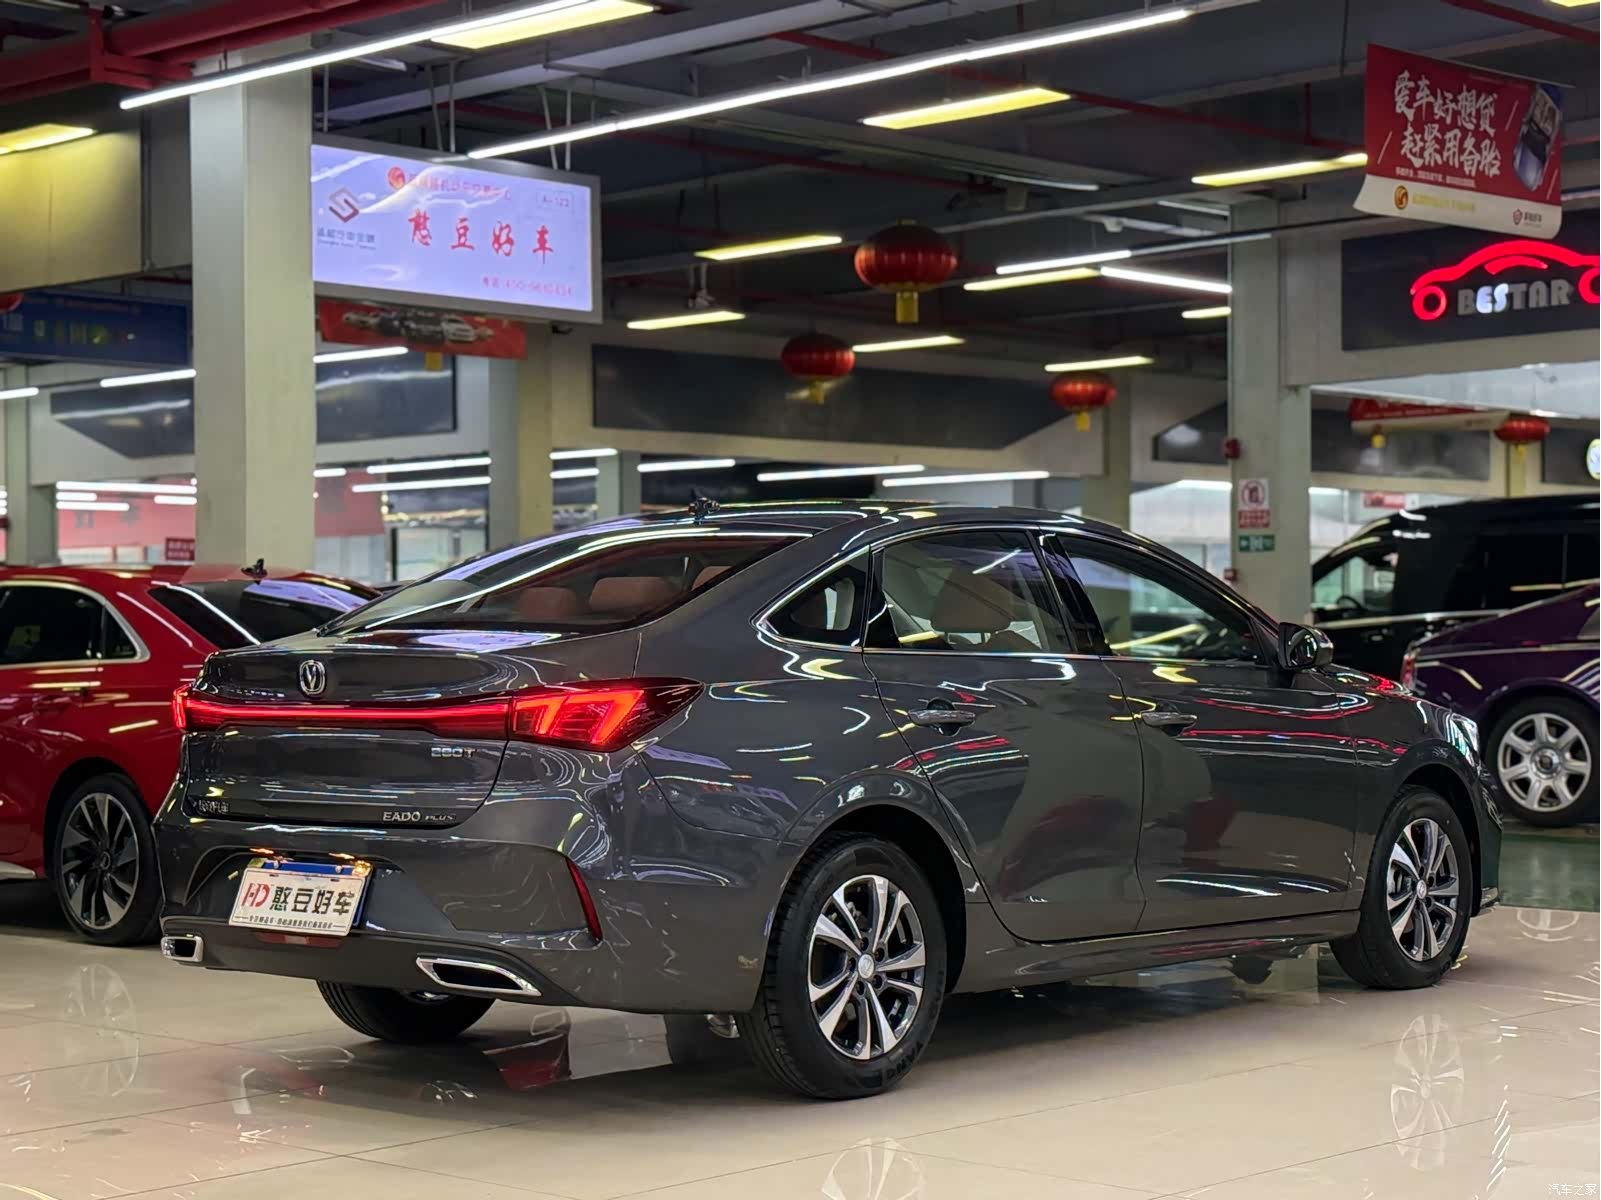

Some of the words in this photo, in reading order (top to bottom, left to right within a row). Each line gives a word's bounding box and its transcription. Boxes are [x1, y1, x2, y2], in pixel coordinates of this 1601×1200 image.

[1394, 69, 1498, 138] 爱车好想贷
[1400, 122, 1501, 178] 赶紧用备胎
[1457, 279, 1571, 315] BESTAR
[382, 811, 421, 822] EADO
[269, 886, 355, 916] 憨豆好车
